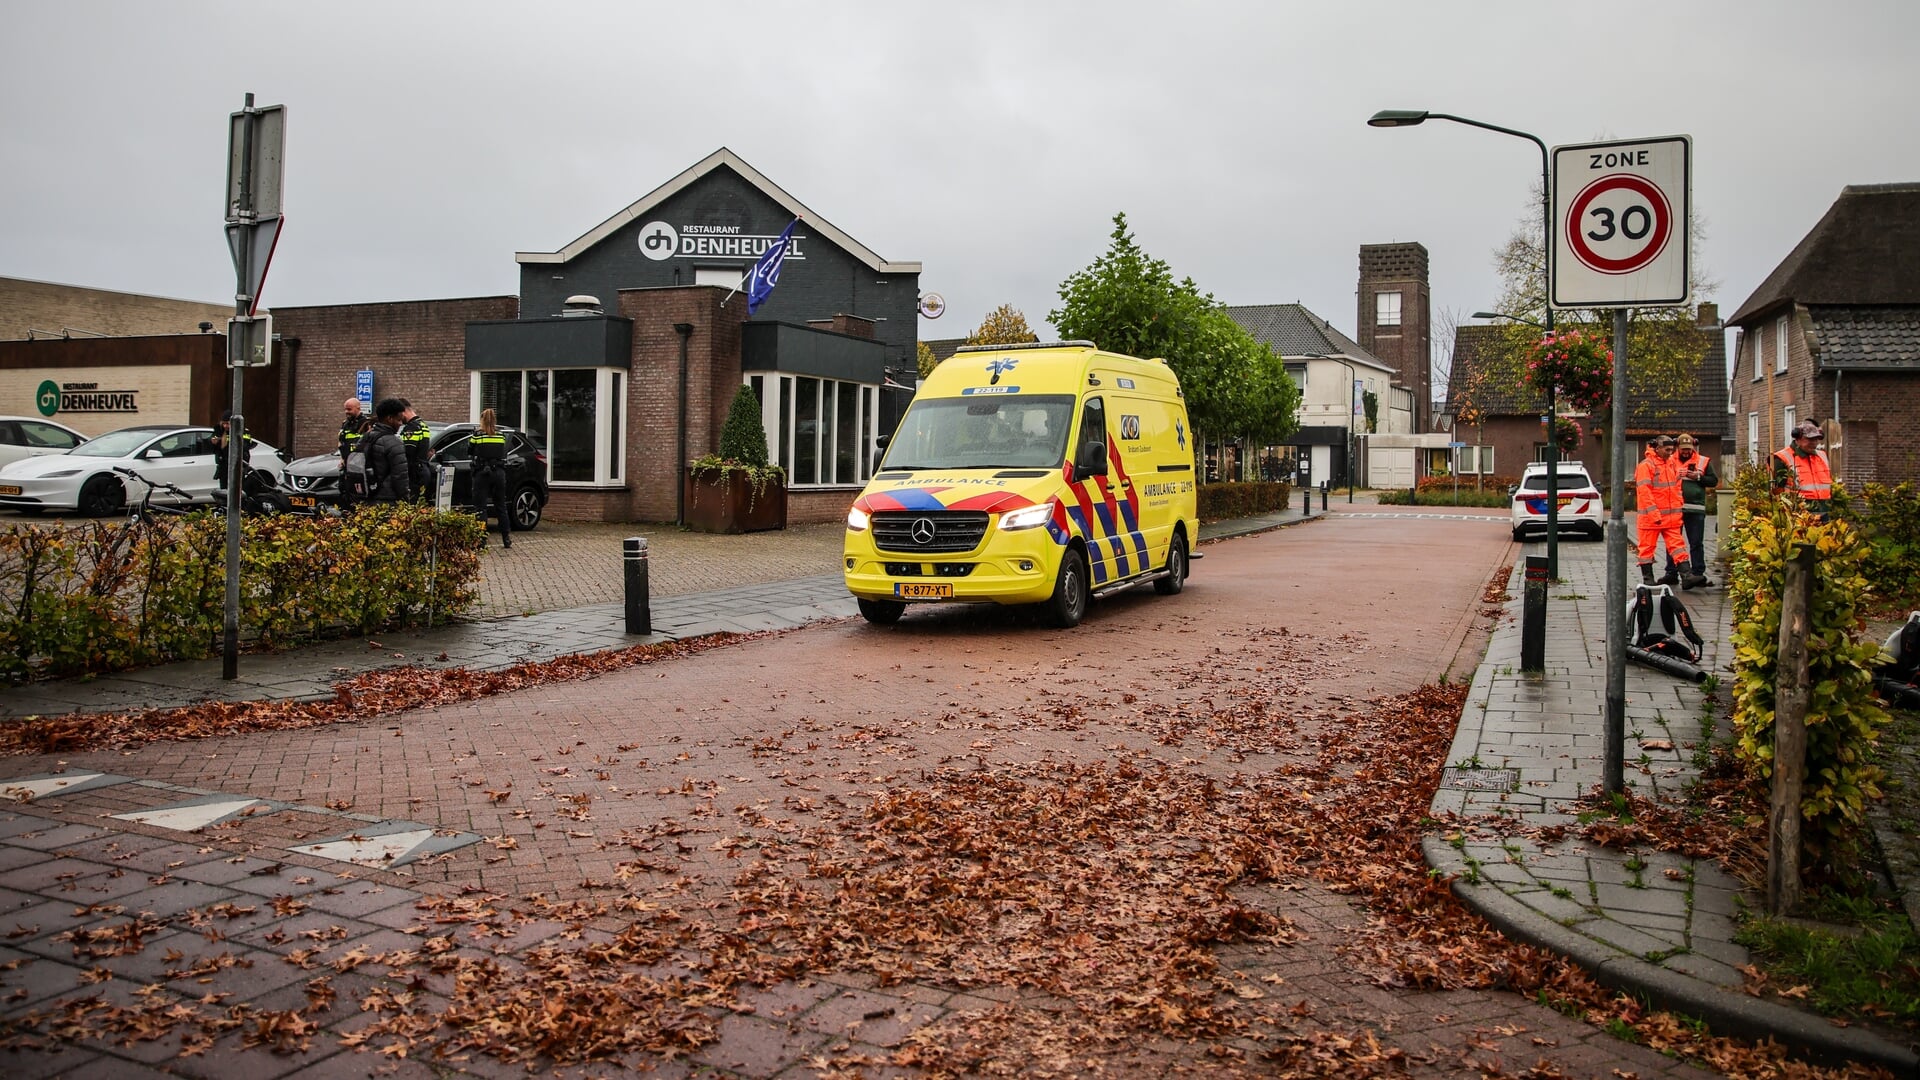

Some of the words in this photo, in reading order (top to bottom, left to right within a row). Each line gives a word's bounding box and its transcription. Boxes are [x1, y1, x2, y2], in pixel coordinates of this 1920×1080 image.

[1590, 151, 1649, 169] ZONE
[683, 225, 740, 234] RESTAURANT
[1587, 206, 1651, 241] 30
[62, 394, 137, 410] DENHEUVEL
[895, 478, 1007, 487] AMBULANCE
[1144, 482, 1176, 497] AMBULANCE
[904, 585, 947, 596] R-877-XT
